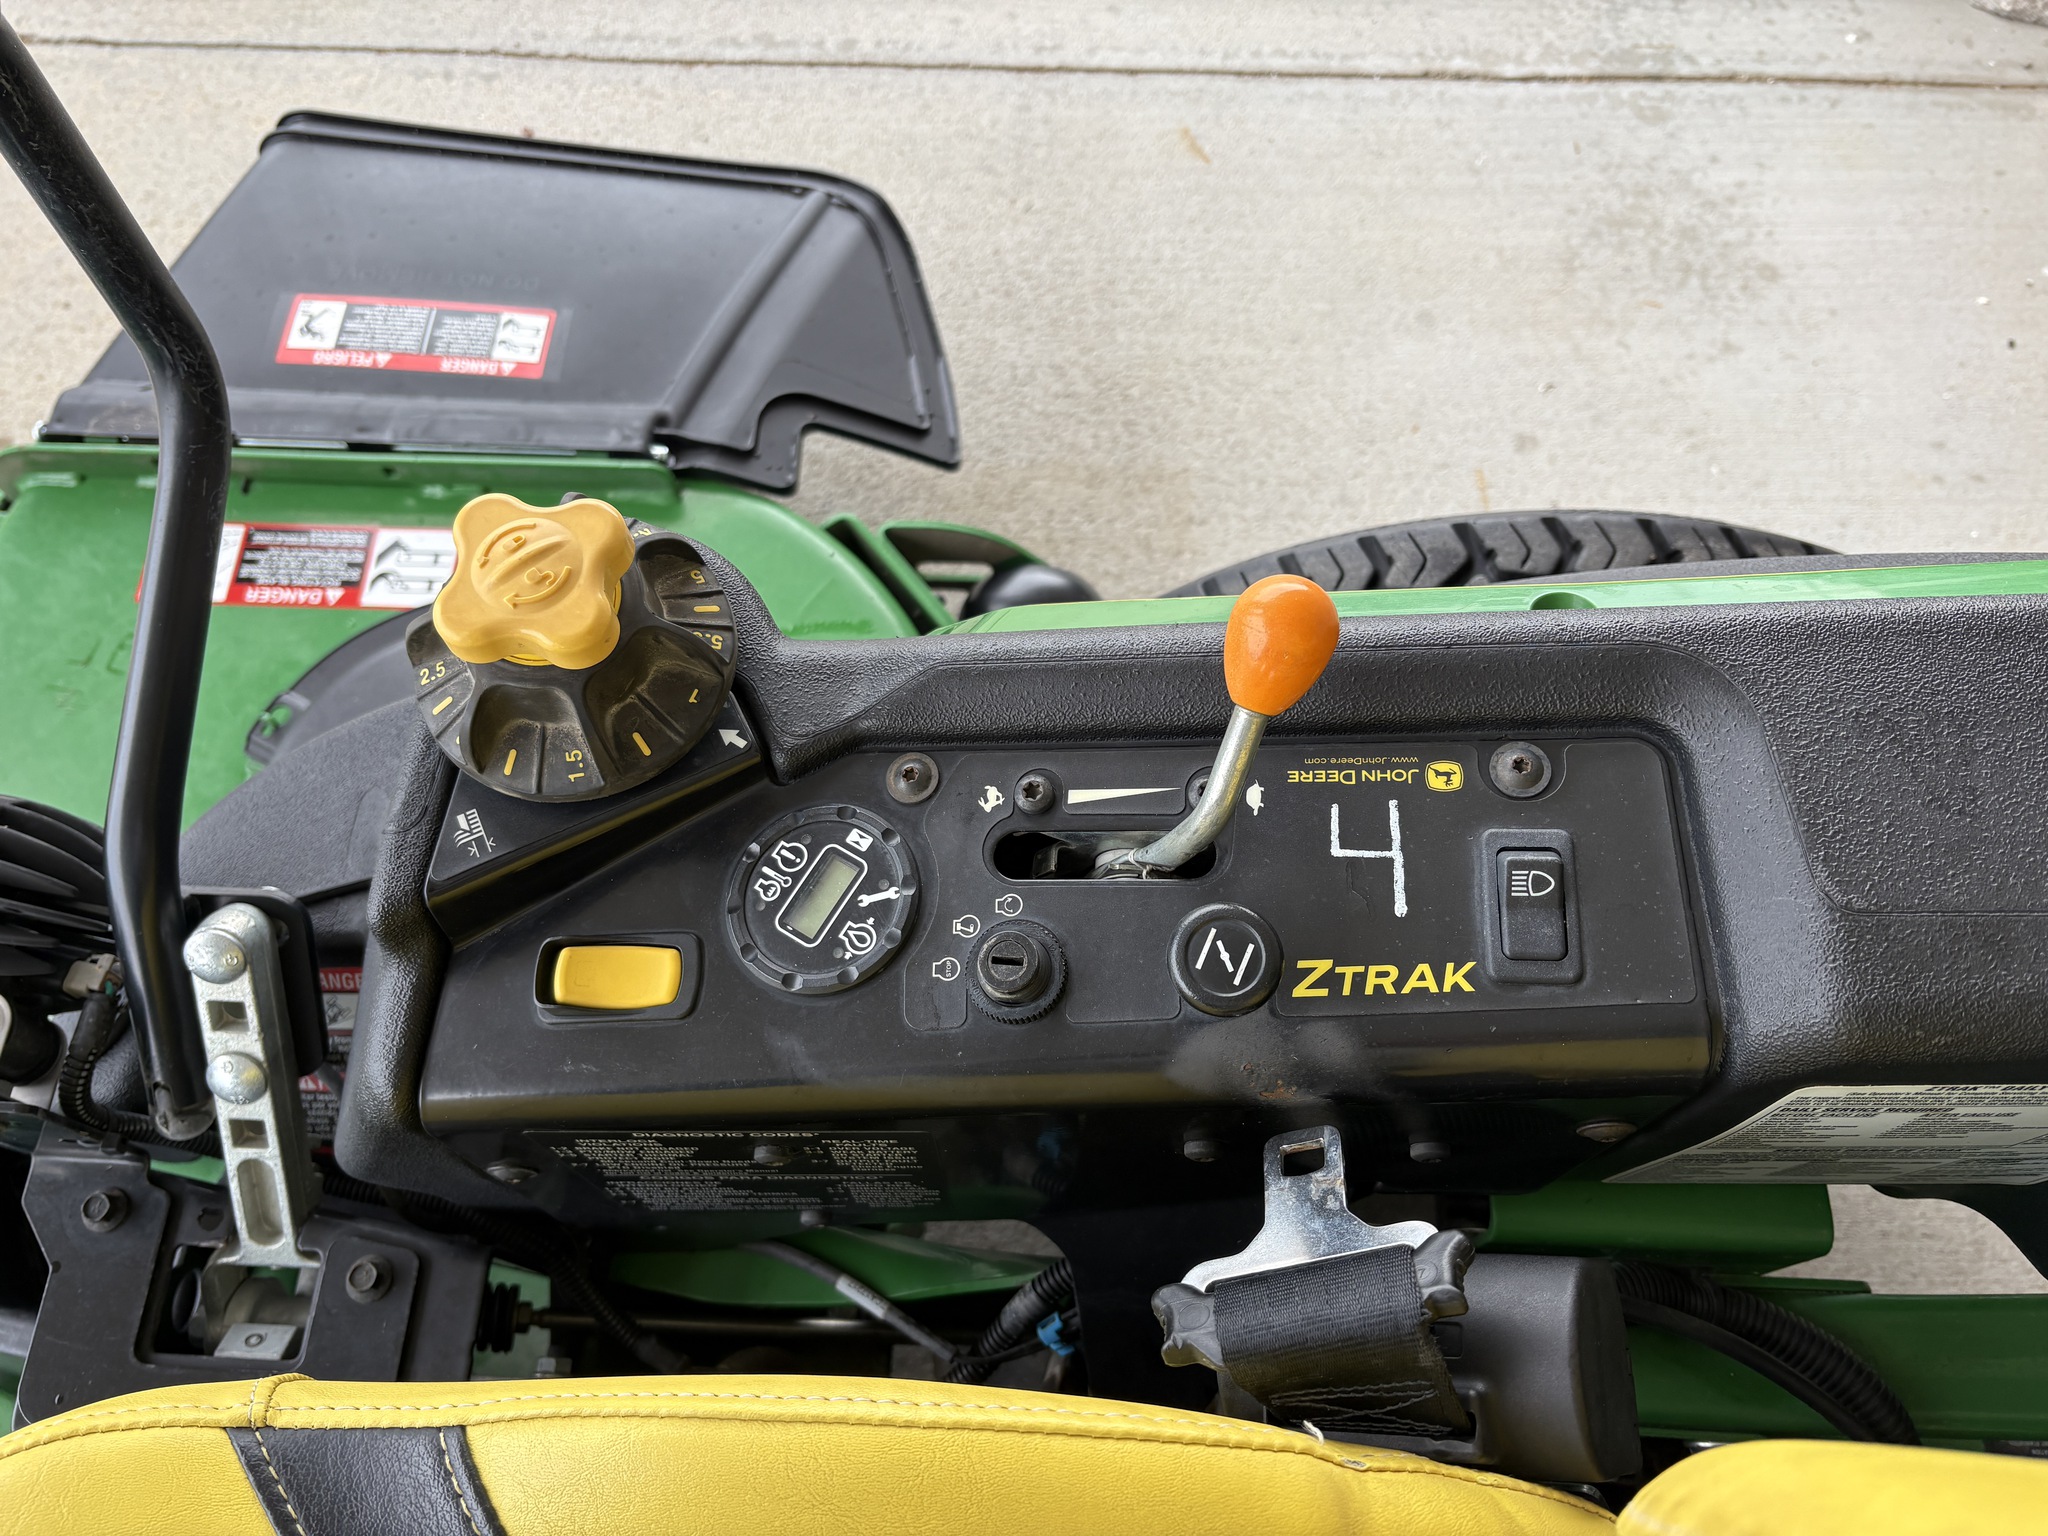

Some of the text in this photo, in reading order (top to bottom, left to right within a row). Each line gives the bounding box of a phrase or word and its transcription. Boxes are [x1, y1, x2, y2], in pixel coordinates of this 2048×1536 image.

[313, 350, 376, 368] PELIGRO
[441, 357, 498, 374] DANGER
[690, 570, 705, 584] 5
[245, 586, 323, 604] DANGER
[420, 661, 446, 685] 2.5
[688, 688, 699, 703] 1
[565, 750, 585, 782] 1.5
[1305, 757, 1419, 765] www.JohnDeere.com
[1287, 769, 1419, 785] JOHN DEERE
[1330, 800, 1408, 917] 4
[1292, 959, 1477, 998] ZTRAK
